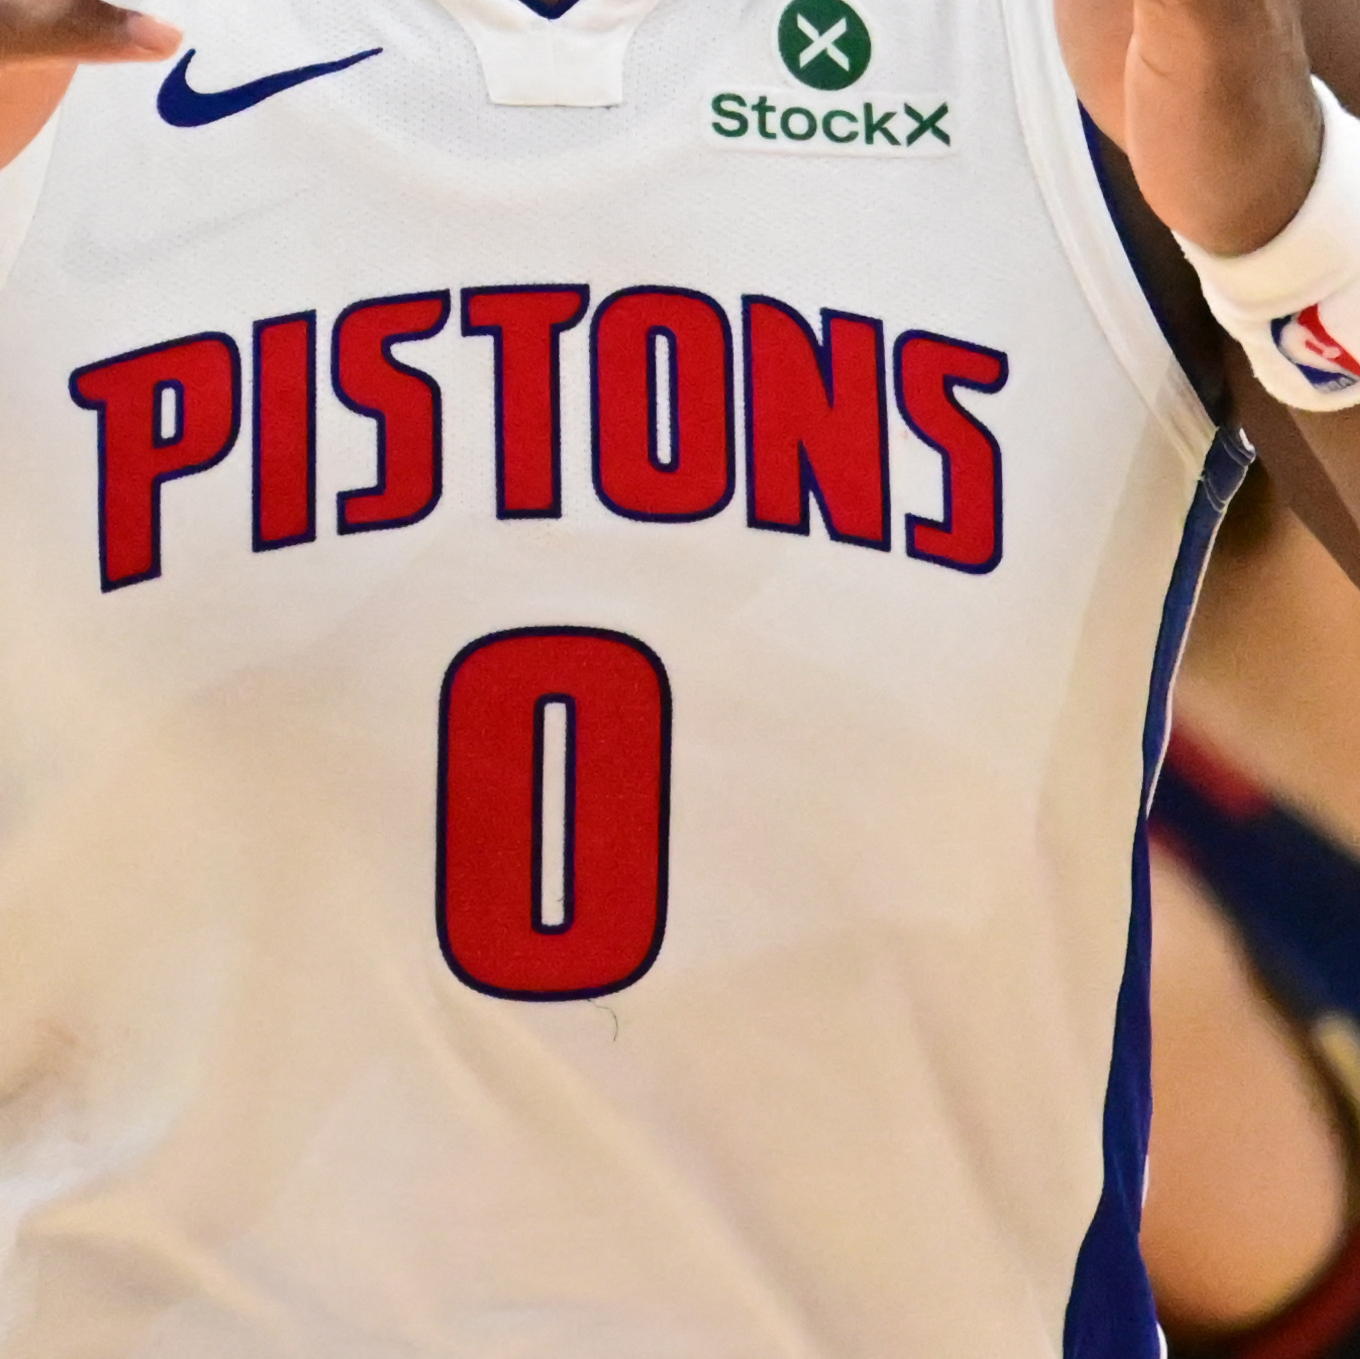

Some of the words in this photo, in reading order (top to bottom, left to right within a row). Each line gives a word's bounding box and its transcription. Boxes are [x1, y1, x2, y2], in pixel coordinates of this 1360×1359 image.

[711, 93, 951, 147] StockX
[796, 13, 850, 71] X
[69, 283, 1009, 594] PISTONS
[435, 625, 673, 1003] 0
